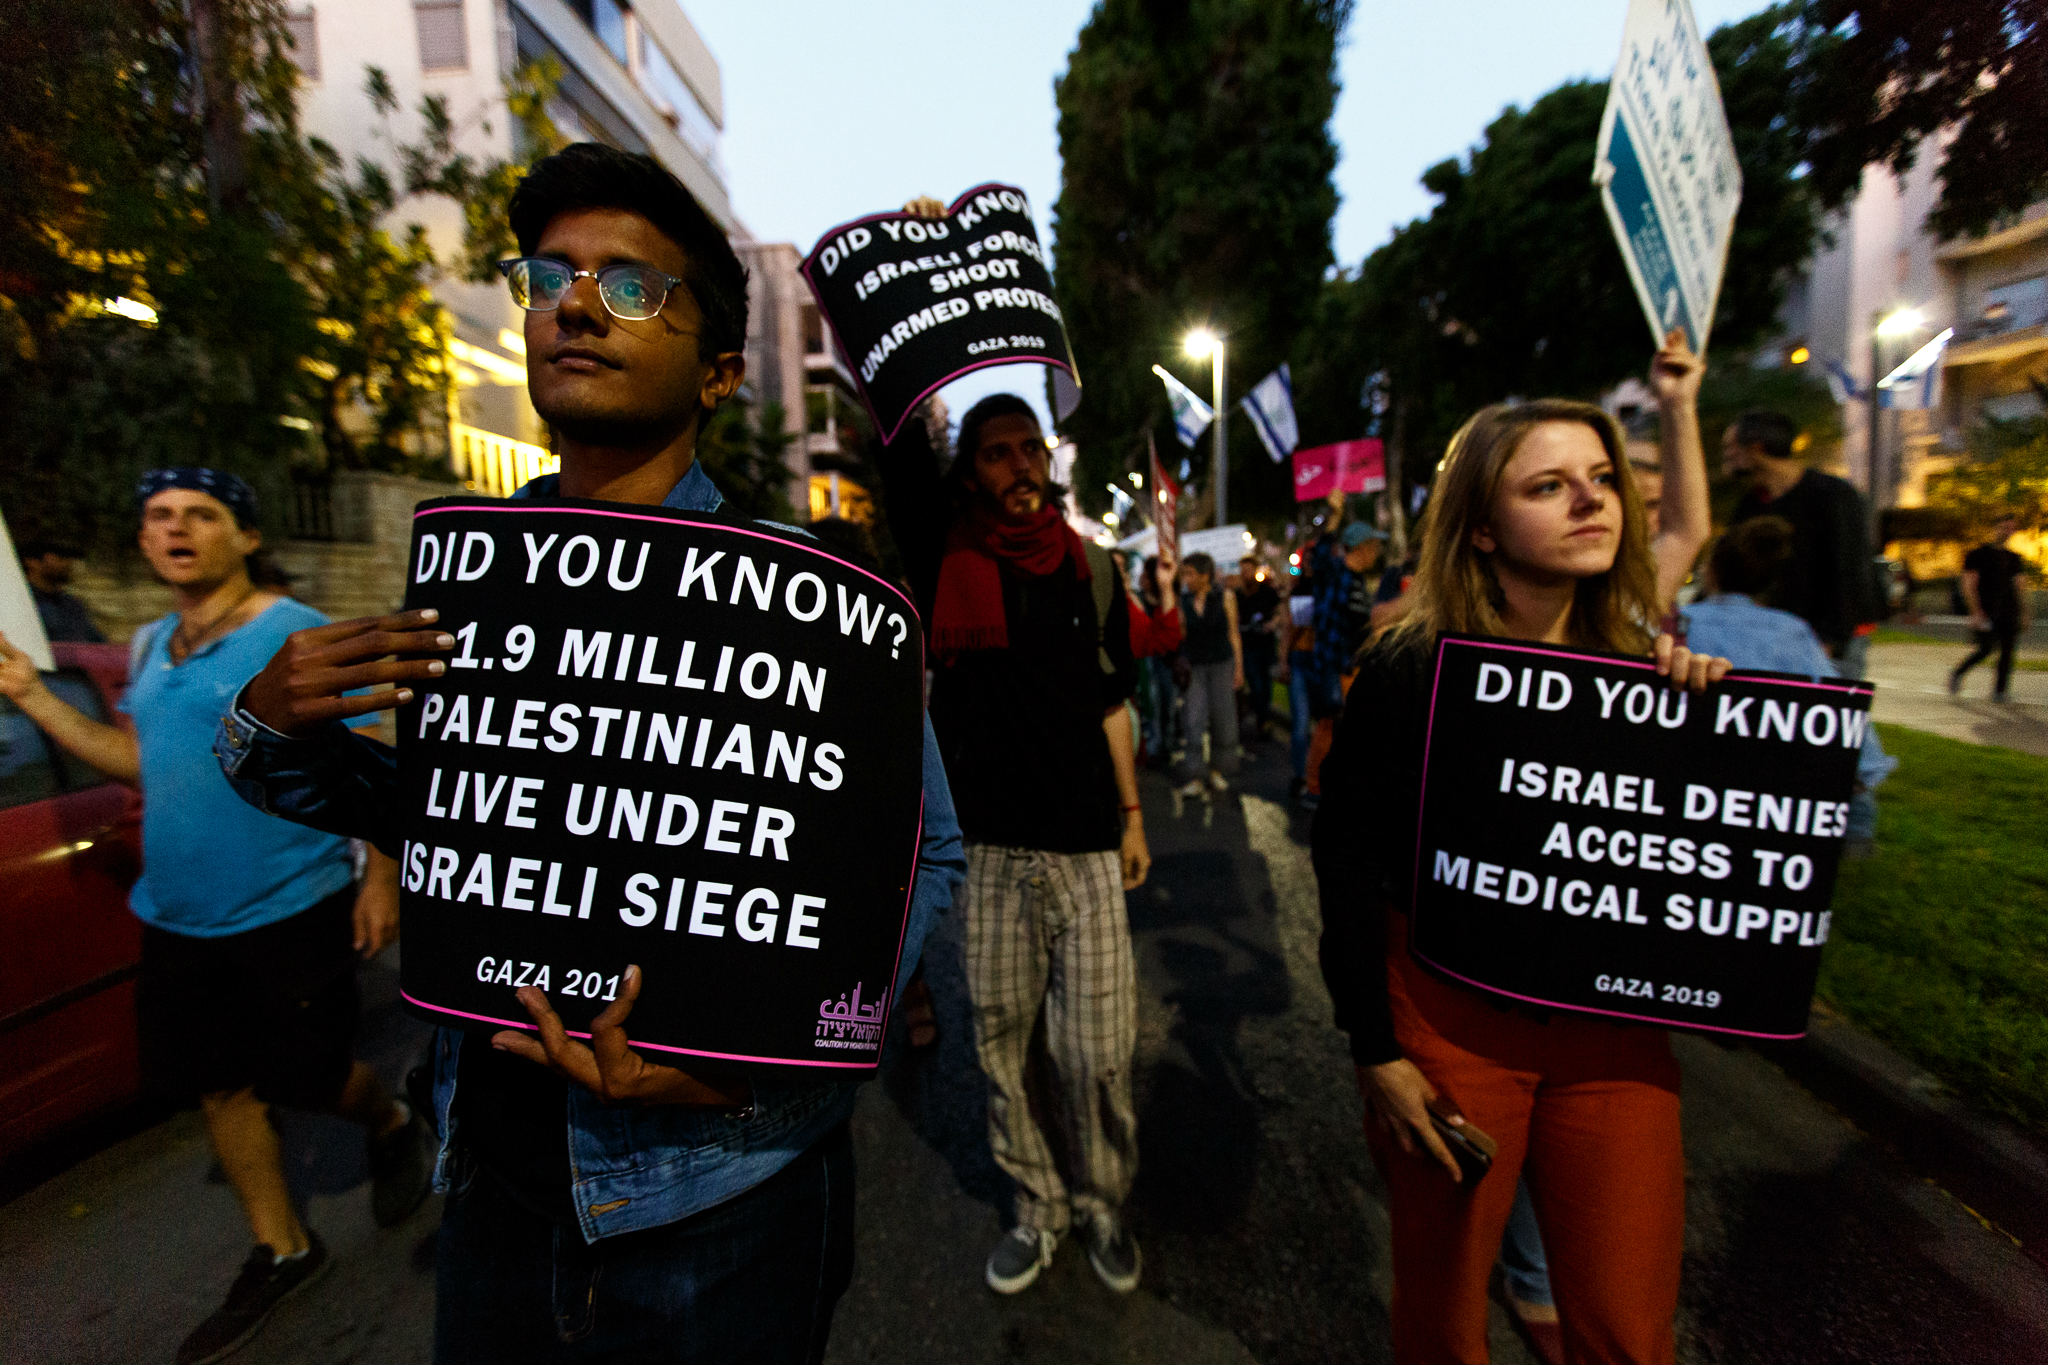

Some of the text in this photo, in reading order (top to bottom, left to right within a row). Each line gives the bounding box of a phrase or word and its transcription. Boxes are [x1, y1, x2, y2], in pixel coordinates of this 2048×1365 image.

[819, 226, 872, 277] DID
[880, 219, 950, 243] YOU
[854, 251, 962, 301] ISRAELI
[929, 258, 1020, 293] SHOOT
[860, 297, 970, 384] UNARMED
[966, 336, 1009, 355] GAZA
[415, 531, 908, 661] DID YOU KNOW?
[450, 621, 827, 713] 1.9 MILLION
[1475, 662, 1573, 711] DID
[1594, 677, 1688, 729] YOU
[418, 692, 846, 791] PALESTINIANS
[426, 768, 796, 862] LIVE UNDER
[1499, 757, 1850, 837] ISRAEL DENIES
[1433, 849, 1649, 925] MEDICAL
[1541, 821, 1814, 891] ACCESS TO
[401, 839, 827, 949] ISRAELI SIEGE
[476, 955, 620, 1002] GAZA 201
[1594, 974, 1721, 1009] GAZA 2019
